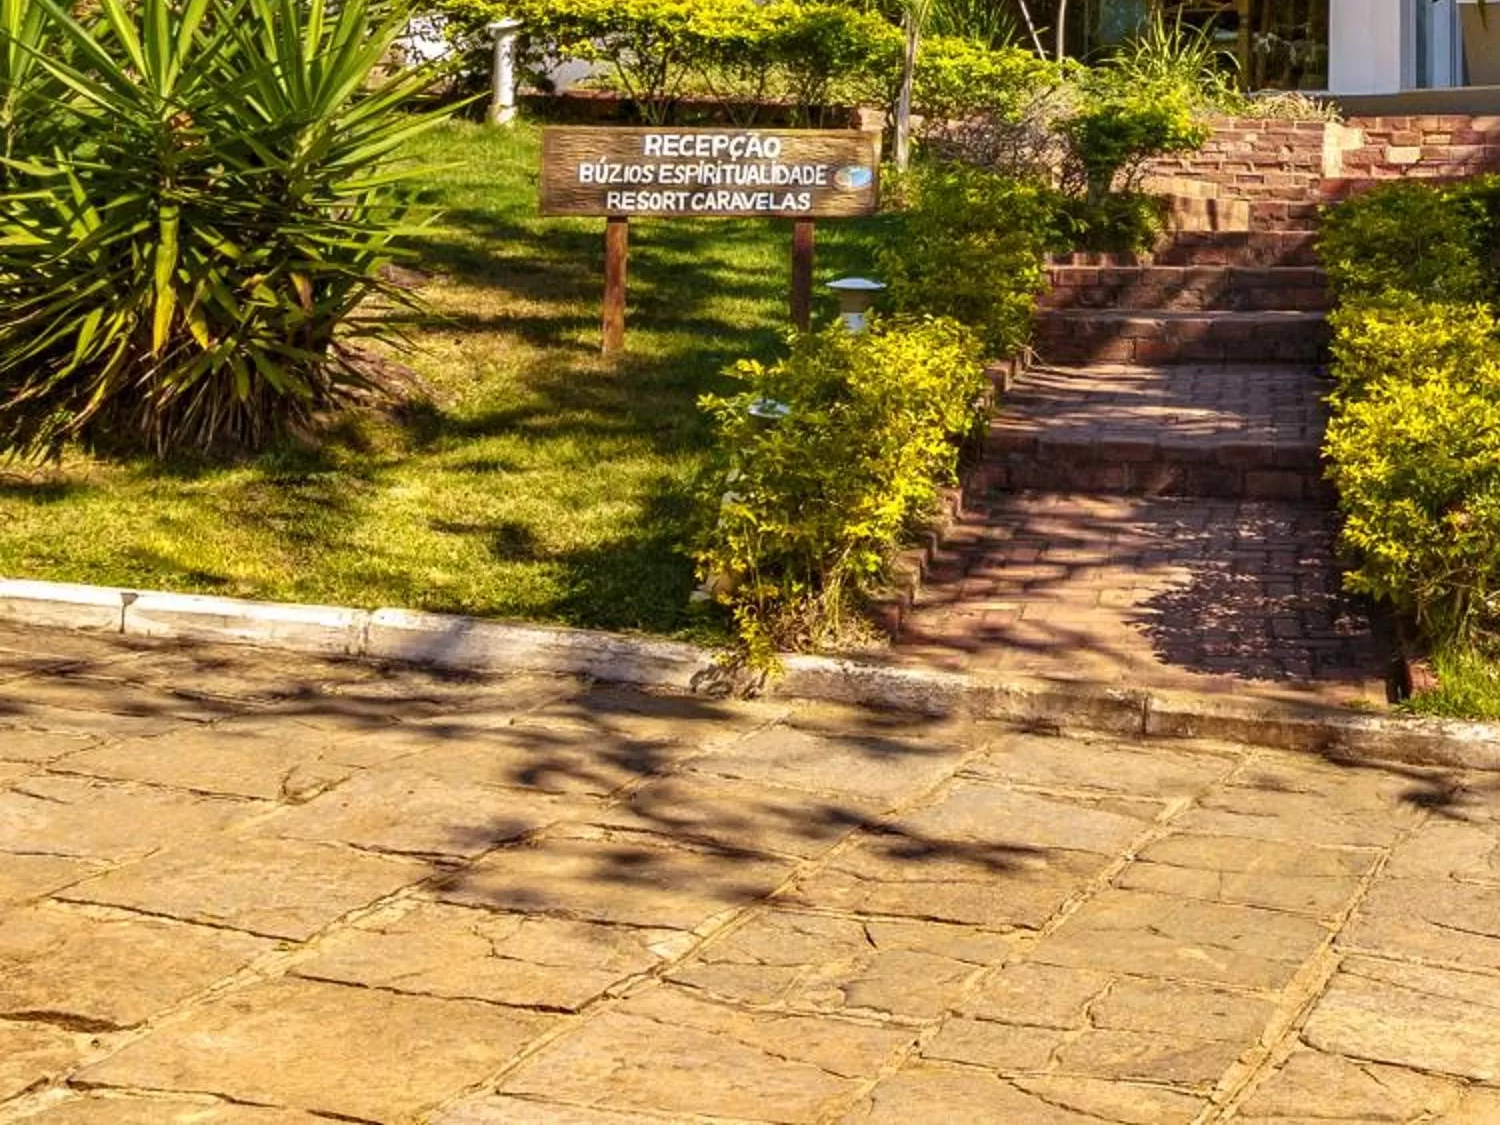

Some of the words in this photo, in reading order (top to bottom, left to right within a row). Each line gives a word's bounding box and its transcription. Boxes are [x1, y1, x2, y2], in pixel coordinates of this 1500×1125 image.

[643, 132, 781, 161] RECEPÇÃO
[579, 156, 655, 184] BÚZIOS
[606, 190, 692, 211] RESORT
[691, 190, 811, 211] CARAVELAS
